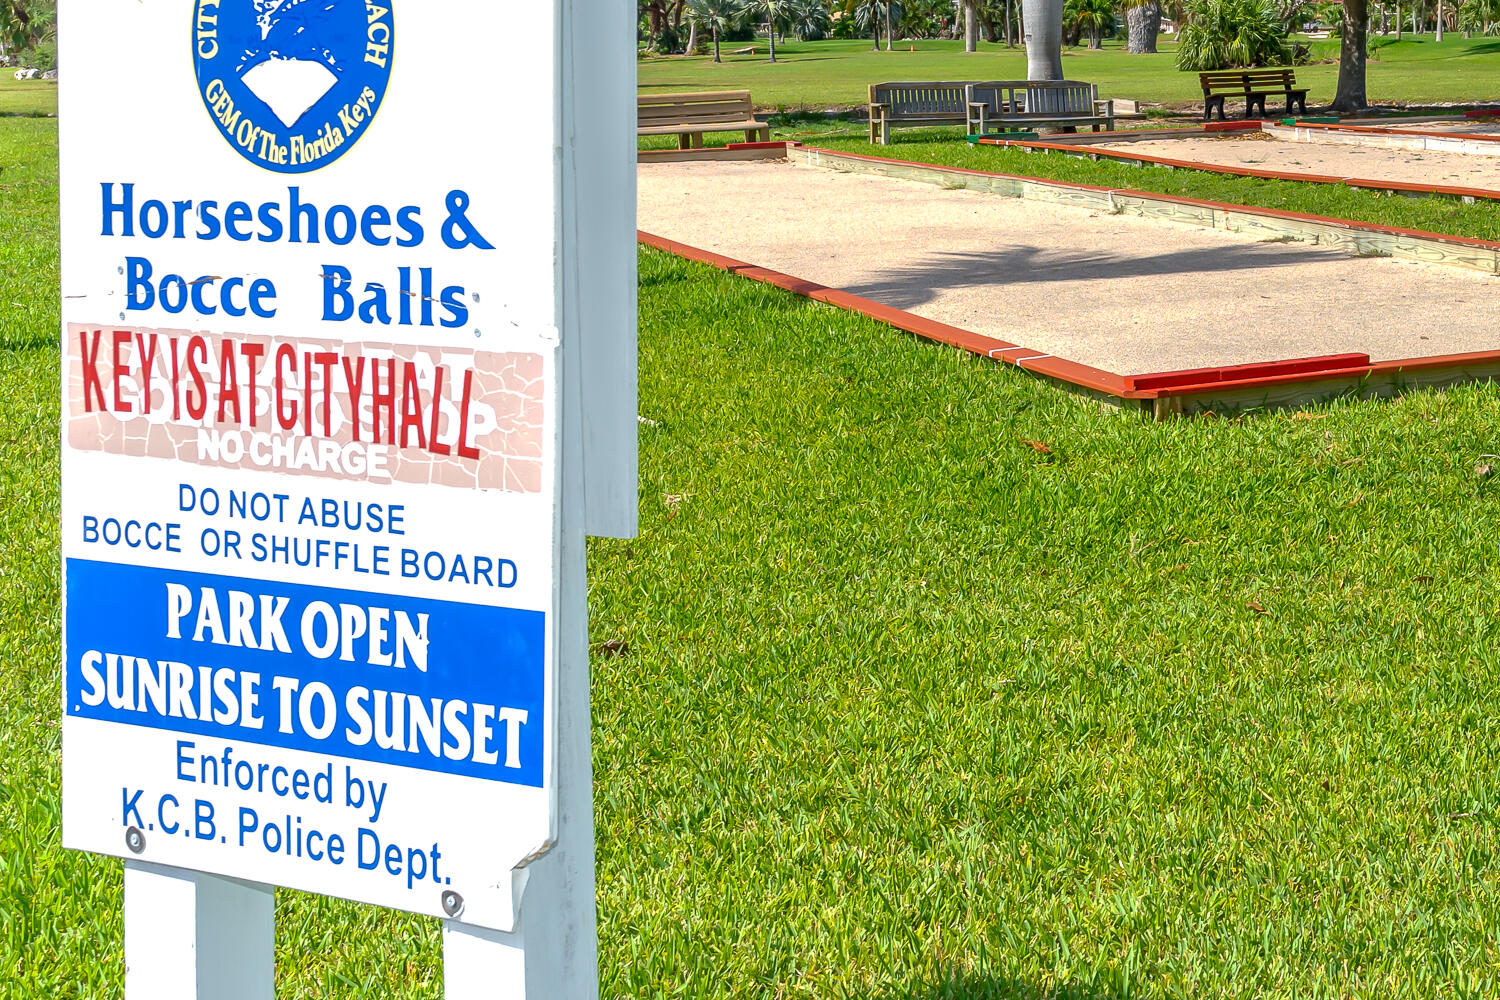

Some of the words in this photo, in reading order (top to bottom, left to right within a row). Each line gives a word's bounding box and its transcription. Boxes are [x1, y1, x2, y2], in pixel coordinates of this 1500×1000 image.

[205, 78, 241, 135] GEM
[236, 119, 261, 152] Of
[258, 132, 287, 165] The
[290, 122, 344, 165] Florida
[338, 86, 376, 136] Keys
[101, 183, 424, 247] Horseshoes
[441, 190, 496, 250] &
[126, 257, 277, 318] Bocce
[321, 265, 468, 328] Balls
[196, 428, 244, 464] NO
[249, 431, 391, 478] CHARGE
[179, 484, 219, 516] DO
[230, 490, 289, 522] NOT
[298, 497, 405, 535] ABUSE
[83, 516, 181, 552] BOCCE
[201, 528, 242, 558] OR
[250, 533, 391, 576] SHUFFLE
[401, 549, 517, 588] BOARD
[166, 582, 292, 653] PARK
[301, 600, 430, 673] OPEN
[80, 651, 264, 731] SUNRISE
[273, 676, 336, 739] TO
[345, 686, 530, 770] SUNSET
[176, 740, 334, 805] Enforced
[345, 766, 389, 823] by
[123, 788, 226, 843] K.C.B.
[239, 808, 344, 864] Police
[358, 828, 450, 889] Dept.
